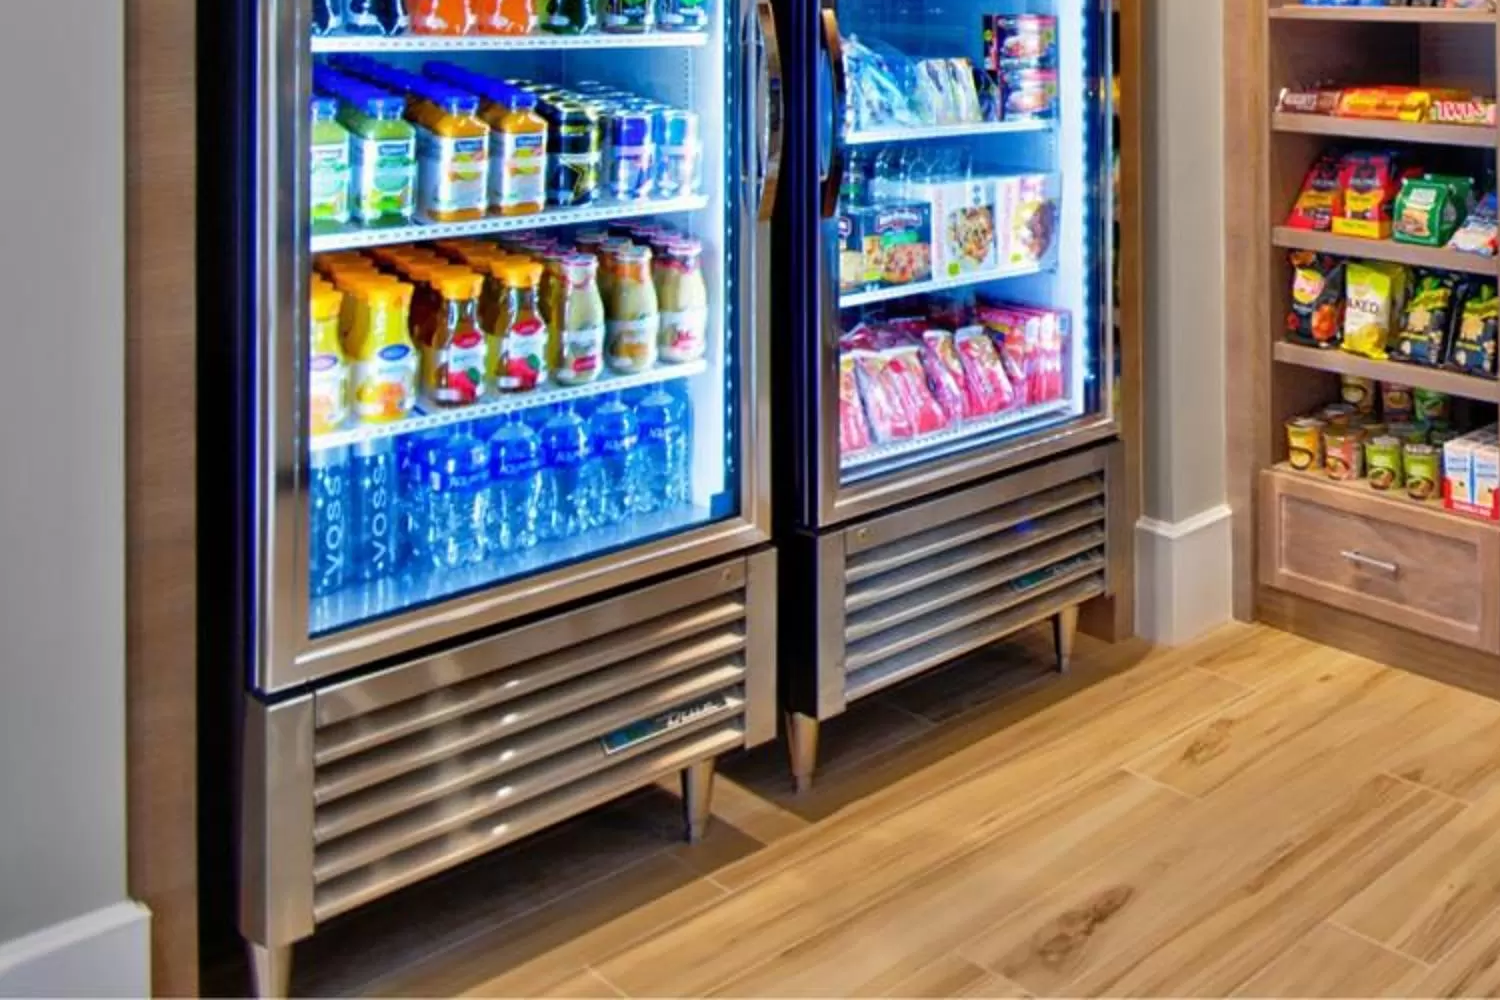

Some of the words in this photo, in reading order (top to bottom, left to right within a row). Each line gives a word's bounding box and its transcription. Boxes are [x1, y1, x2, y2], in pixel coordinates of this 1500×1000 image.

[1438, 99, 1482, 119] TWIX
[324, 474, 343, 577] VOSS
[372, 465, 388, 563] VOSS
